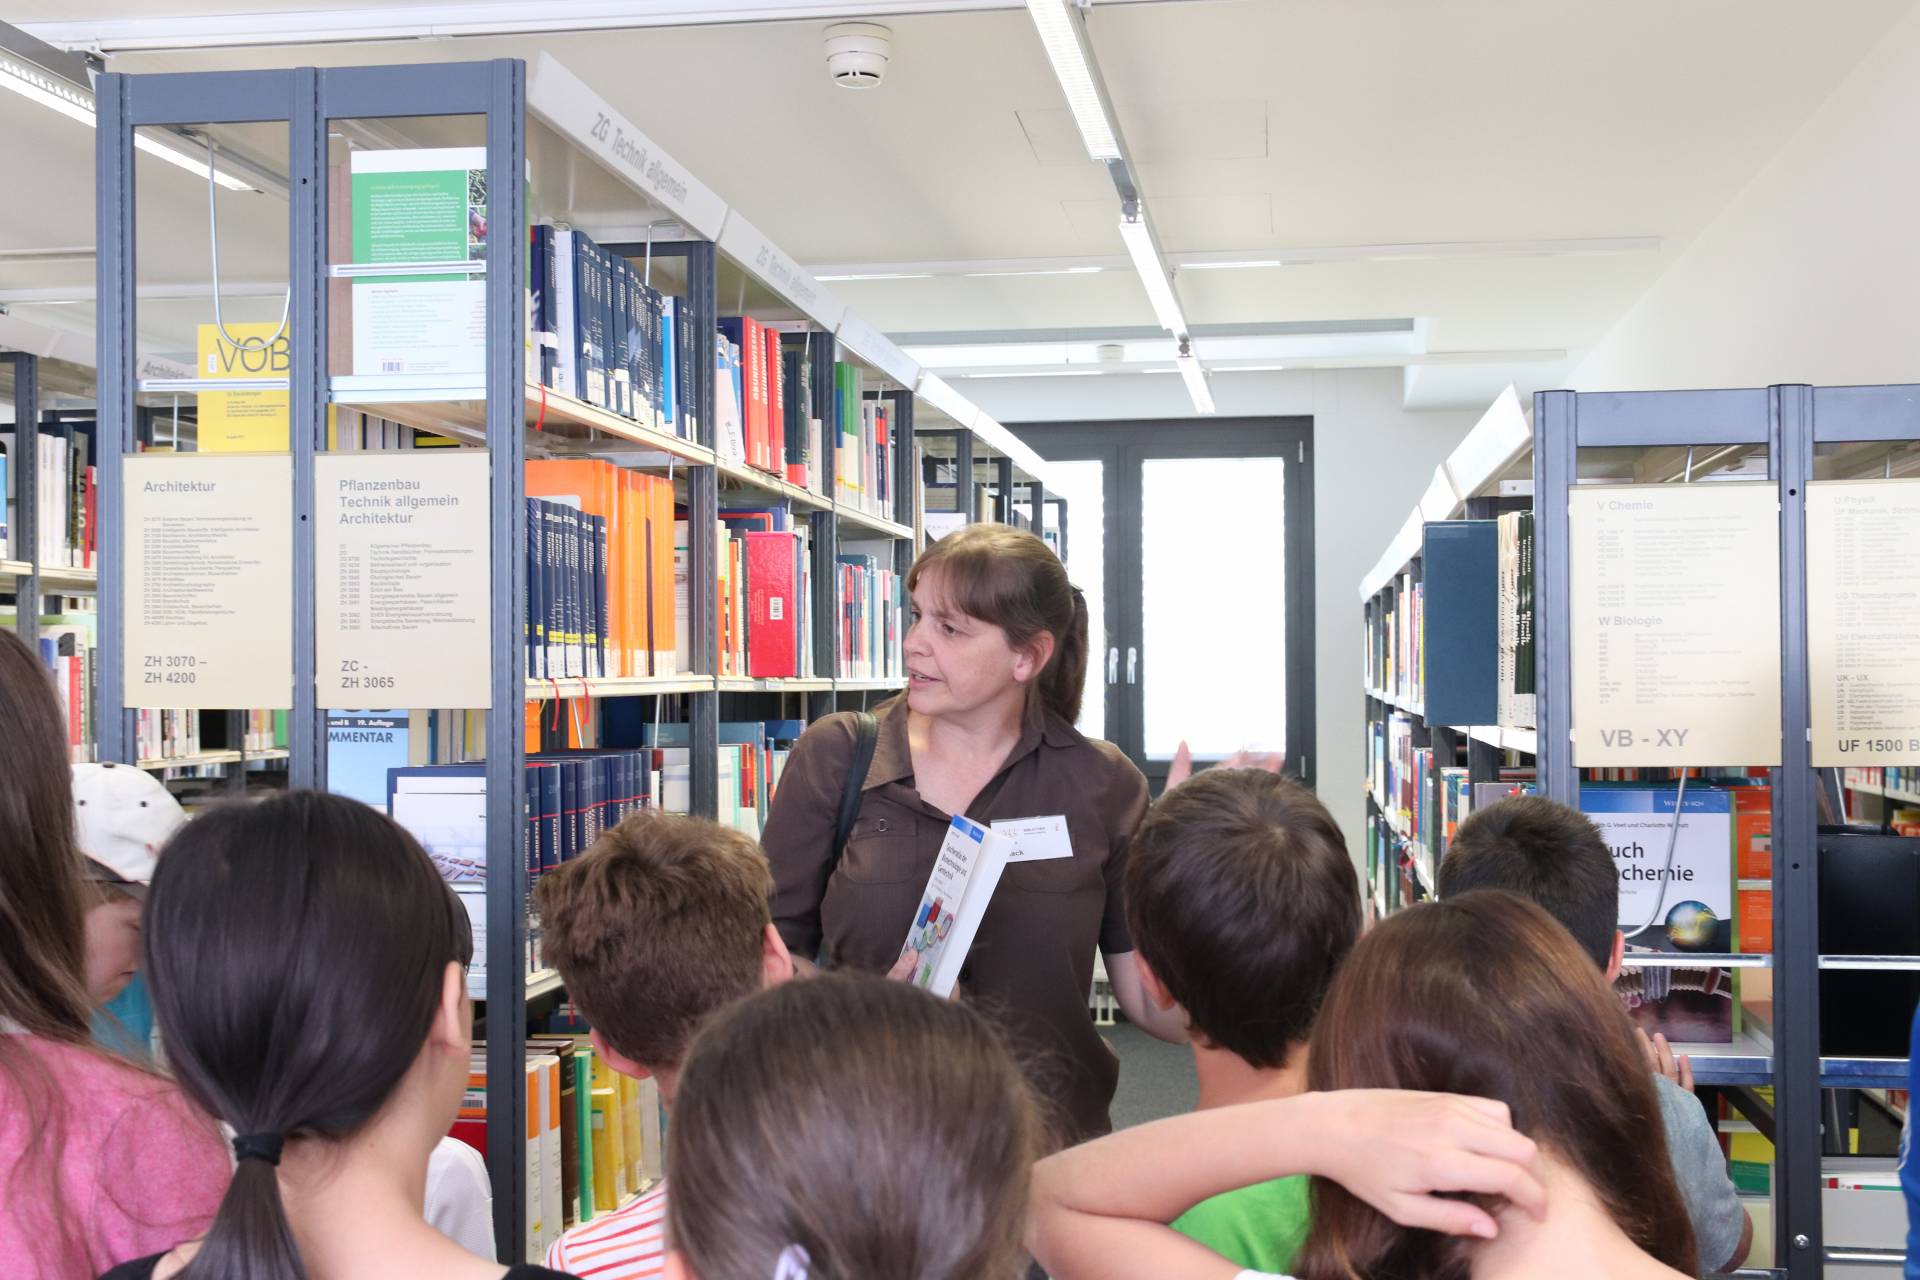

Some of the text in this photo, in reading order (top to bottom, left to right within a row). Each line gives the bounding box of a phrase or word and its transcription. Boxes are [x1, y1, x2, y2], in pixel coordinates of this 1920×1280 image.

[591, 112, 688, 201] ZG Technik allgemein
[216, 336, 289, 372] VOB
[144, 481, 216, 492] Architektur
[339, 479, 420, 491] Pflanzenbau
[339, 495, 458, 509] Technik allgemein
[1597, 500, 1653, 511] V Chemie
[339, 512, 413, 524] Architektur
[1599, 615, 1662, 628] W Biologie
[144, 655, 162, 667] ZH
[166, 655, 195, 667] 3070
[341, 661, 359, 672] ZC
[144, 672, 196, 683] ZH 4200
[341, 677, 394, 688] ZH 3065
[368, 719, 394, 727] Auflage
[328, 732, 393, 742] MMENTAR
[1601, 730, 1633, 747] VB
[1656, 729, 1688, 746] XY
[1839, 739, 1920, 752] UF 1500 B
[1609, 842, 1644, 858] uch
[1618, 865, 1693, 881] chemie
